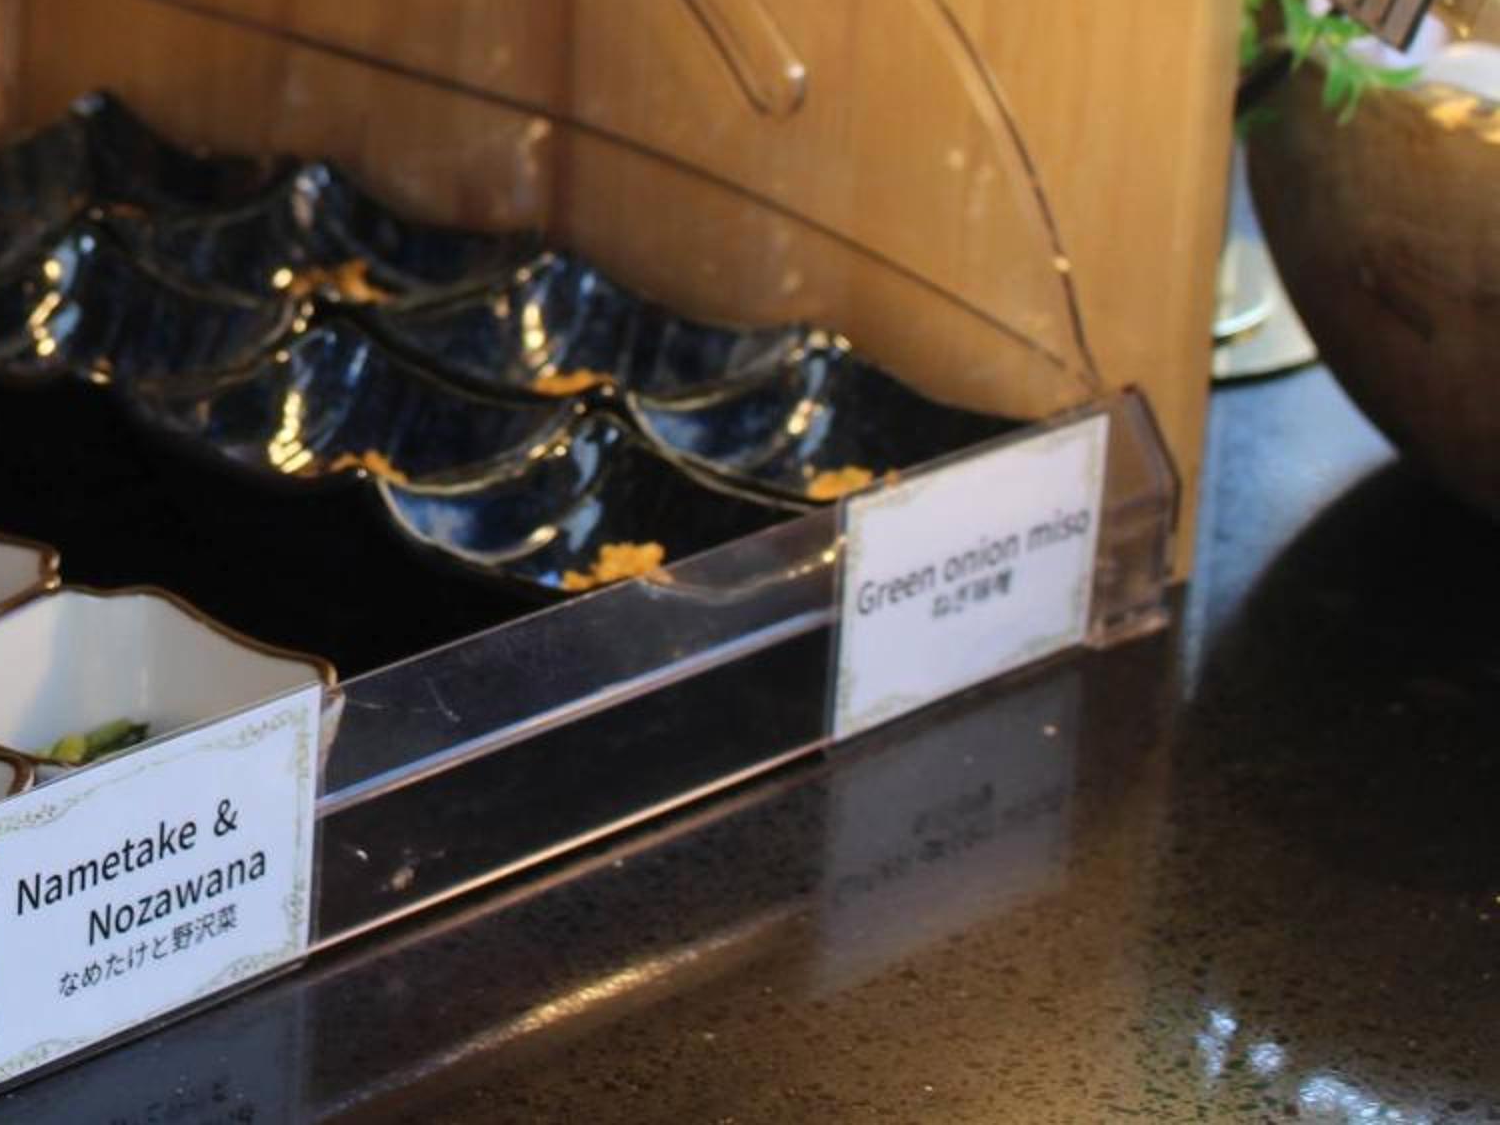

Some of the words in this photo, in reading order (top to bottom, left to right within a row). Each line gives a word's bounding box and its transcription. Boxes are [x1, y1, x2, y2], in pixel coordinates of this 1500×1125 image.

[857, 564, 937, 616] Green
[944, 533, 1019, 583] onion
[1026, 509, 1091, 553] miso
[15, 821, 198, 916] Nametake
[212, 799, 238, 838] &
[87, 850, 267, 946] Nozawana
[58, 904, 239, 997] なめたけと野沢菜
